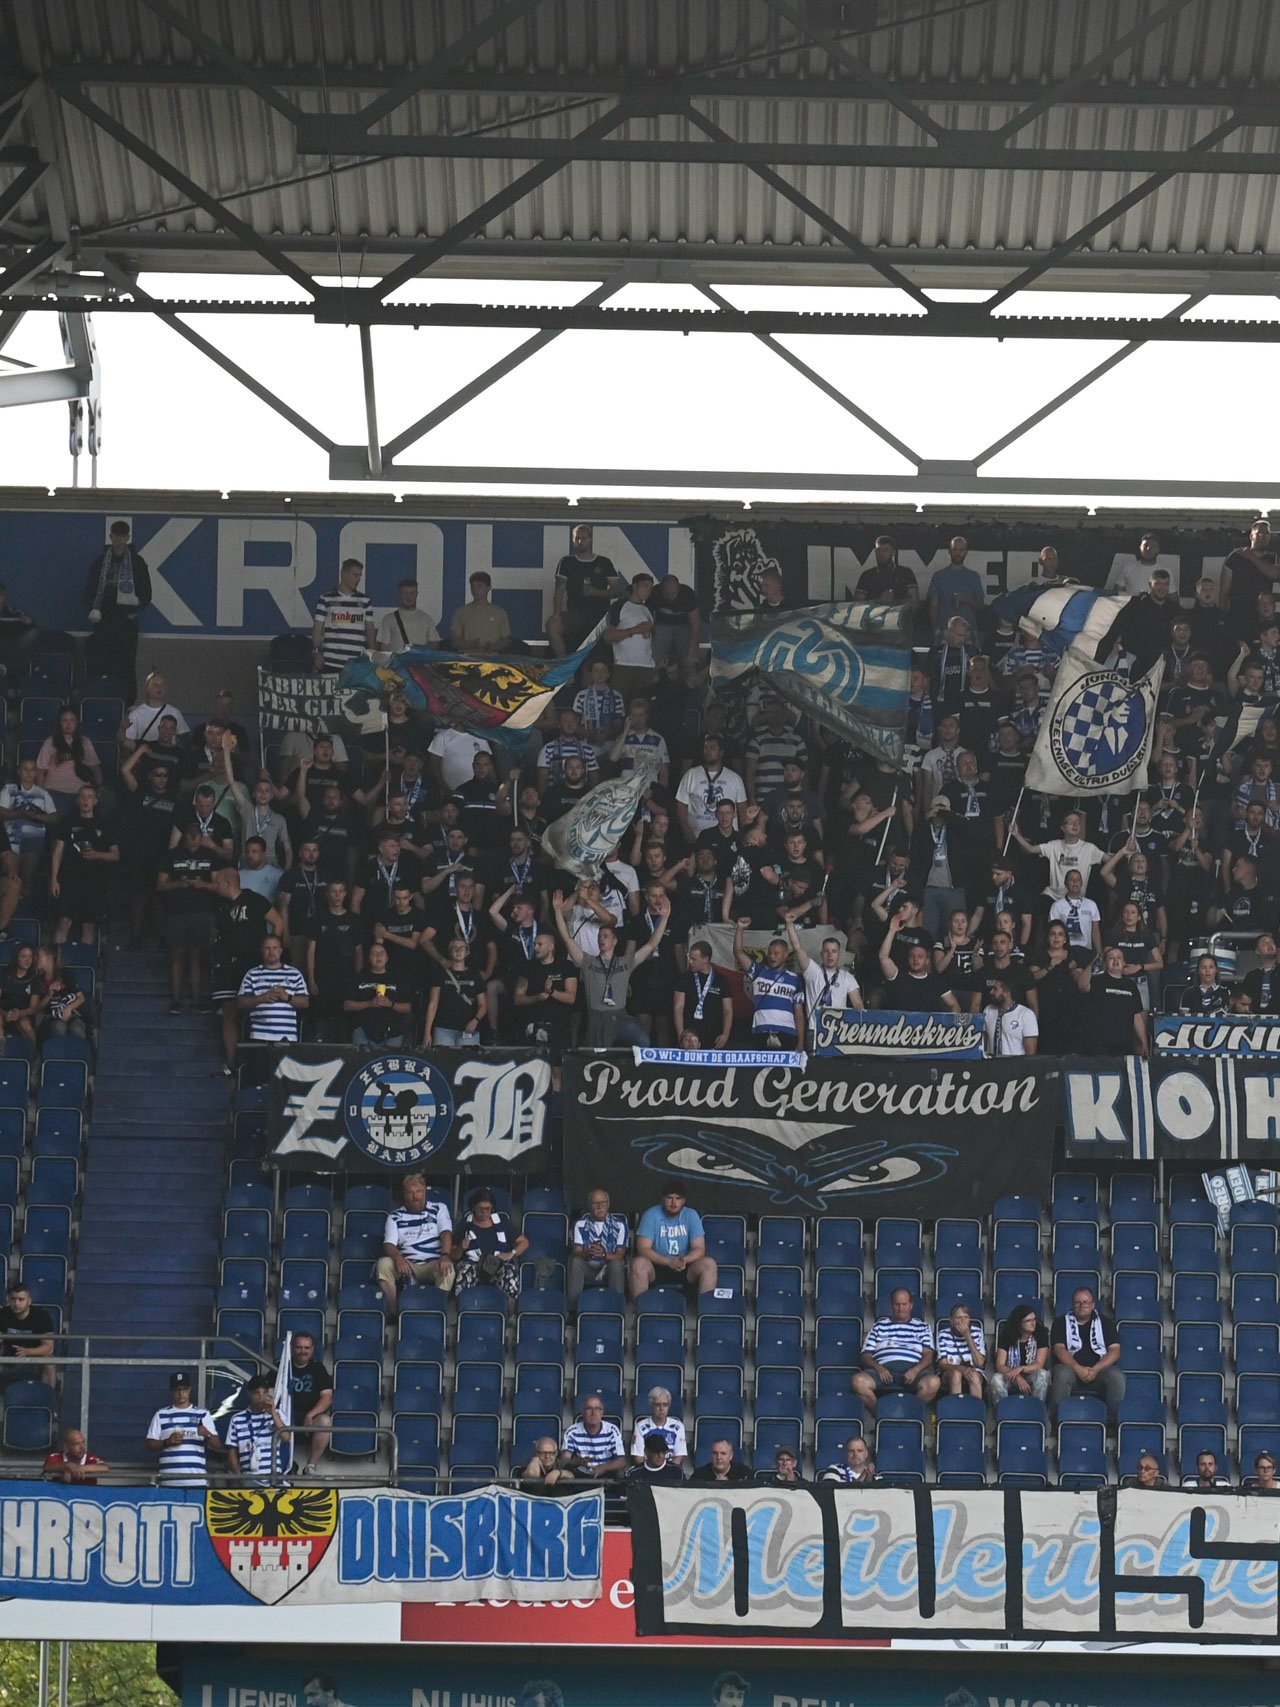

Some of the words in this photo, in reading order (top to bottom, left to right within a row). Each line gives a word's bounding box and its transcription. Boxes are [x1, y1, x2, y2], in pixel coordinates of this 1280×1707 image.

[330, 612, 364, 624] trinkgut
[304, 698, 343, 716] GLI
[1053, 718, 1076, 778] TEENAGE
[1073, 774, 1110, 786] ULTRA
[817, 1008, 982, 1049] Freundeskreis
[683, 1050, 709, 1062] BUNT
[711, 1051, 723, 1063] DE
[724, 1052, 787, 1064] GRAAFSCHAP
[359, 1059, 431, 1087] ZEBRA
[577, 1059, 739, 1109] Proud
[752, 1064, 1040, 1118] Generation
[365, 1140, 434, 1164] BANDE
[339, 1493, 601, 1585] DUISBURG
